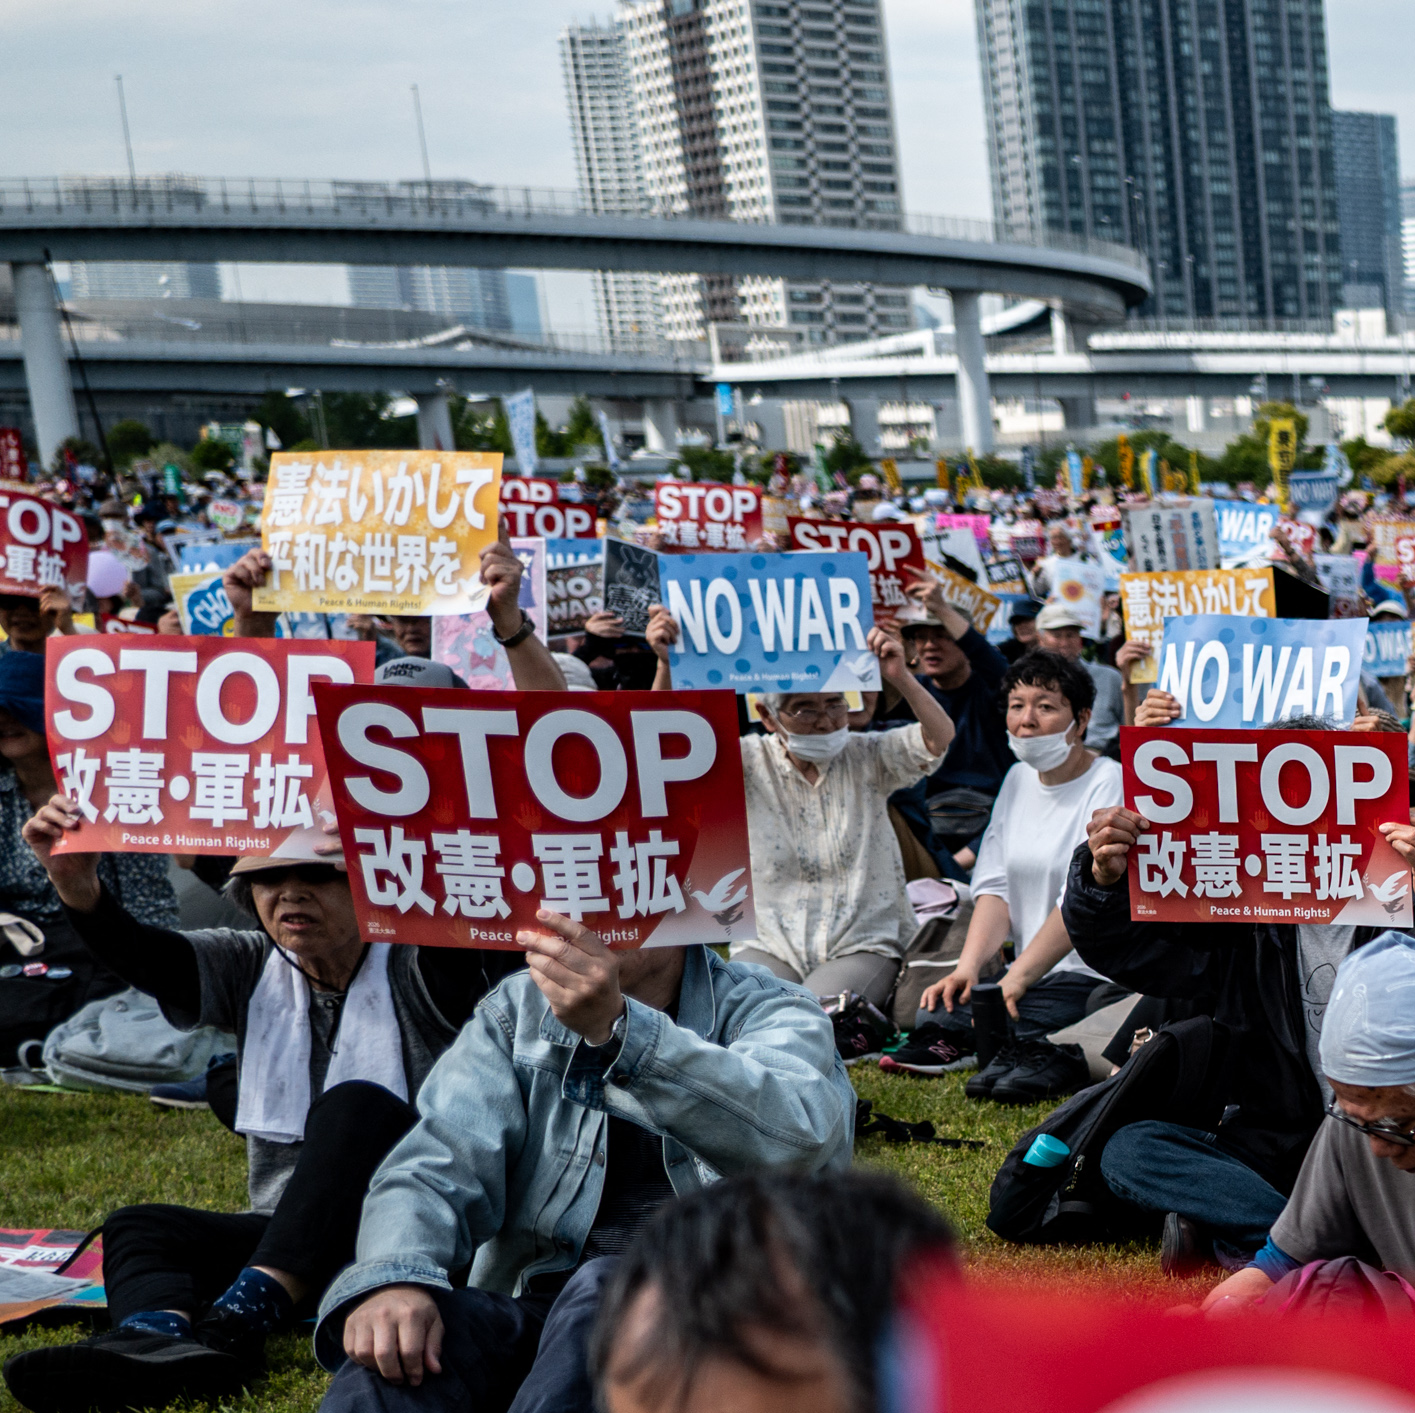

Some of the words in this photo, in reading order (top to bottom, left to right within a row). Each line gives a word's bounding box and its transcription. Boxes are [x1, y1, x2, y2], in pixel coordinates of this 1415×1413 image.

[267, 460, 494, 530] 憲法いかして
[657, 485, 757, 522] STOP
[0, 496, 82, 551] OP
[794, 521, 912, 572] STOP
[1219, 508, 1274, 542] WAR
[0, 545, 65, 591] ・軍拡
[267, 531, 461, 596] 平和な世界を
[547, 576, 593, 601] NO
[319, 597, 344, 608] Peace
[355, 599, 388, 609] Human
[390, 599, 422, 610] Rights!
[667, 577, 743, 655] NO
[748, 577, 869, 653] WAR
[1124, 576, 1269, 626] 憲法いかして
[1378, 627, 1412, 665] WA
[53, 648, 355, 746] STOP
[1159, 639, 1230, 722] NO
[1242, 639, 1351, 722] WAR
[55, 747, 314, 830] 改憲・軍拡
[337, 702, 717, 823] STOP
[1133, 739, 1393, 826] STOP
[122, 832, 161, 846] Peace
[162, 833, 173, 846] &
[176, 834, 223, 848] Human
[225, 835, 270, 850] Rights!
[1135, 831, 1365, 901] 改憲・軍拡
[352, 825, 687, 922] 改憲・軍拡
[470, 928, 513, 942] Peace
[1210, 905, 1241, 917] Peace
[1243, 906, 1251, 917] &
[1254, 906, 1291, 918] Human
[1294, 907, 1331, 920] Rights!
